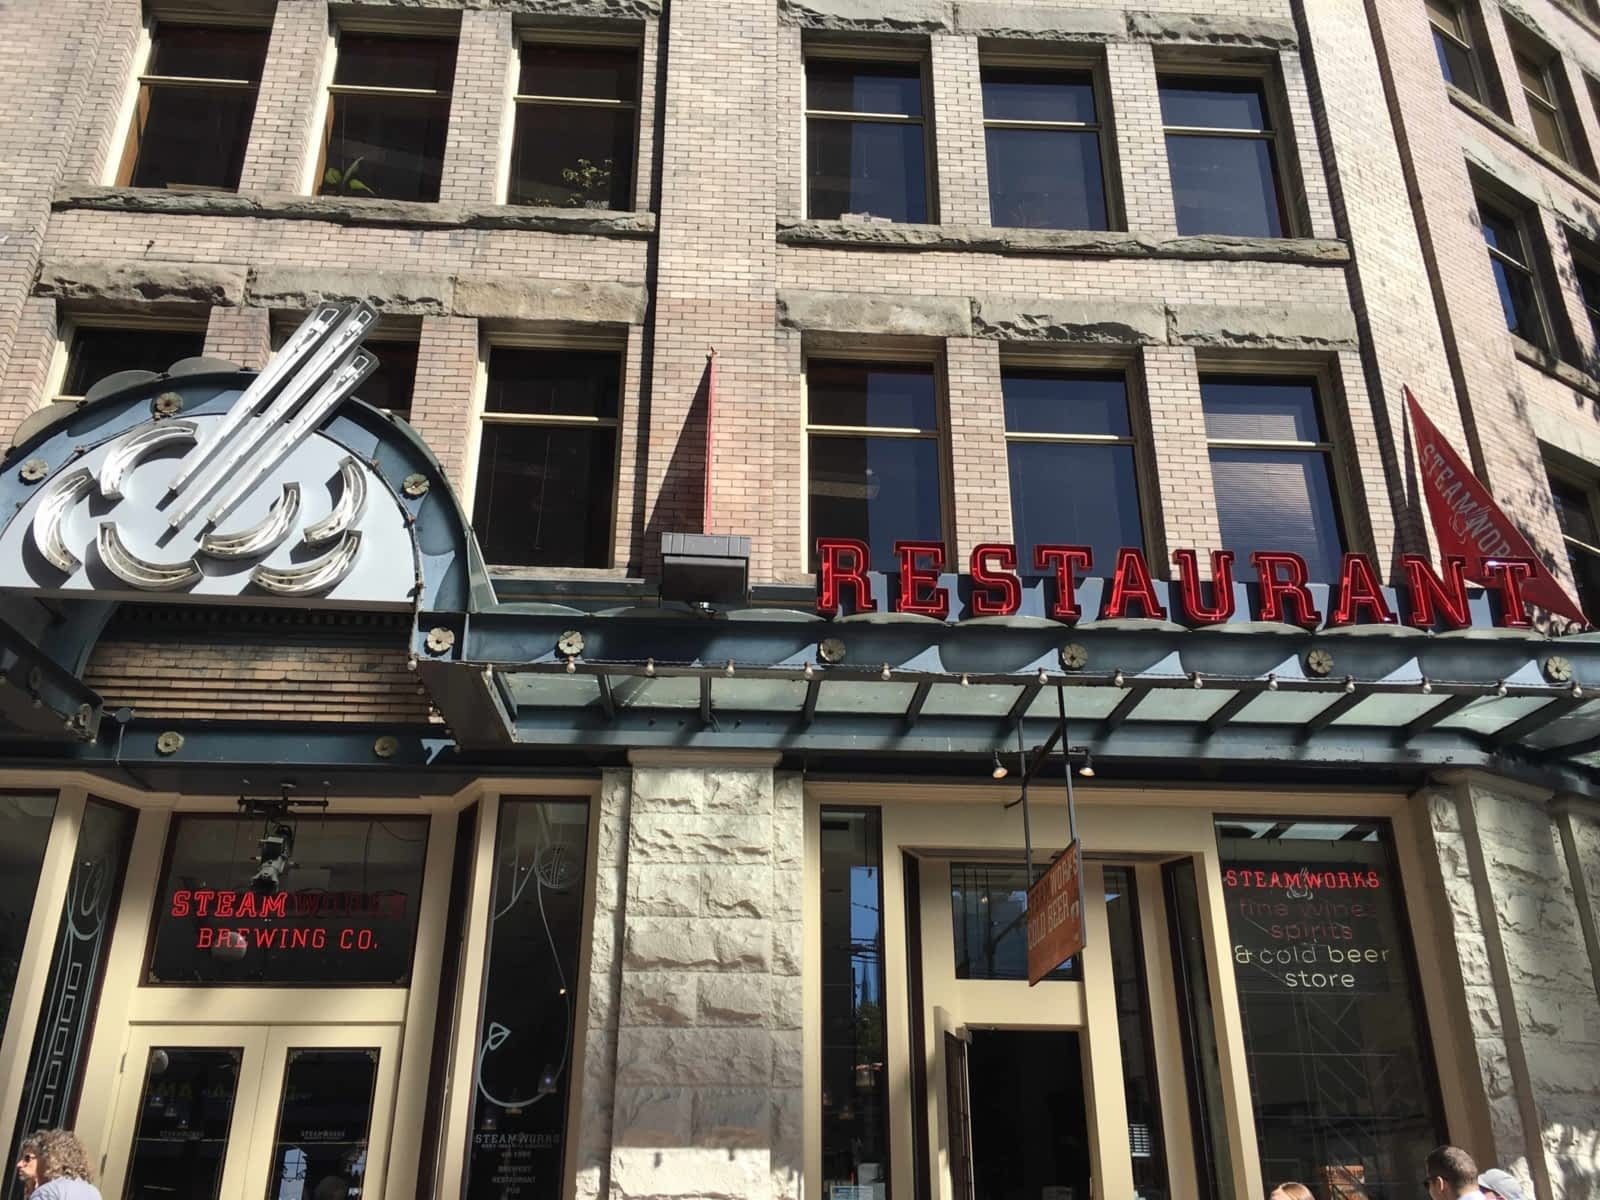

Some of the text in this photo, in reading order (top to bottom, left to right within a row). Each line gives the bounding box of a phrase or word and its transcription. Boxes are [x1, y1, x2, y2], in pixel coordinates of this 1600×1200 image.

[1422, 443, 1513, 558] STEAMWOR
[816, 537, 1536, 629] RESTAURANT
[1226, 869, 1381, 889] STEAMWORKS
[196, 928, 379, 950] BREWING CO.
[1271, 921, 1353, 942] spirits
[1234, 945, 1391, 964] & cold beer
[1285, 970, 1356, 988] store
